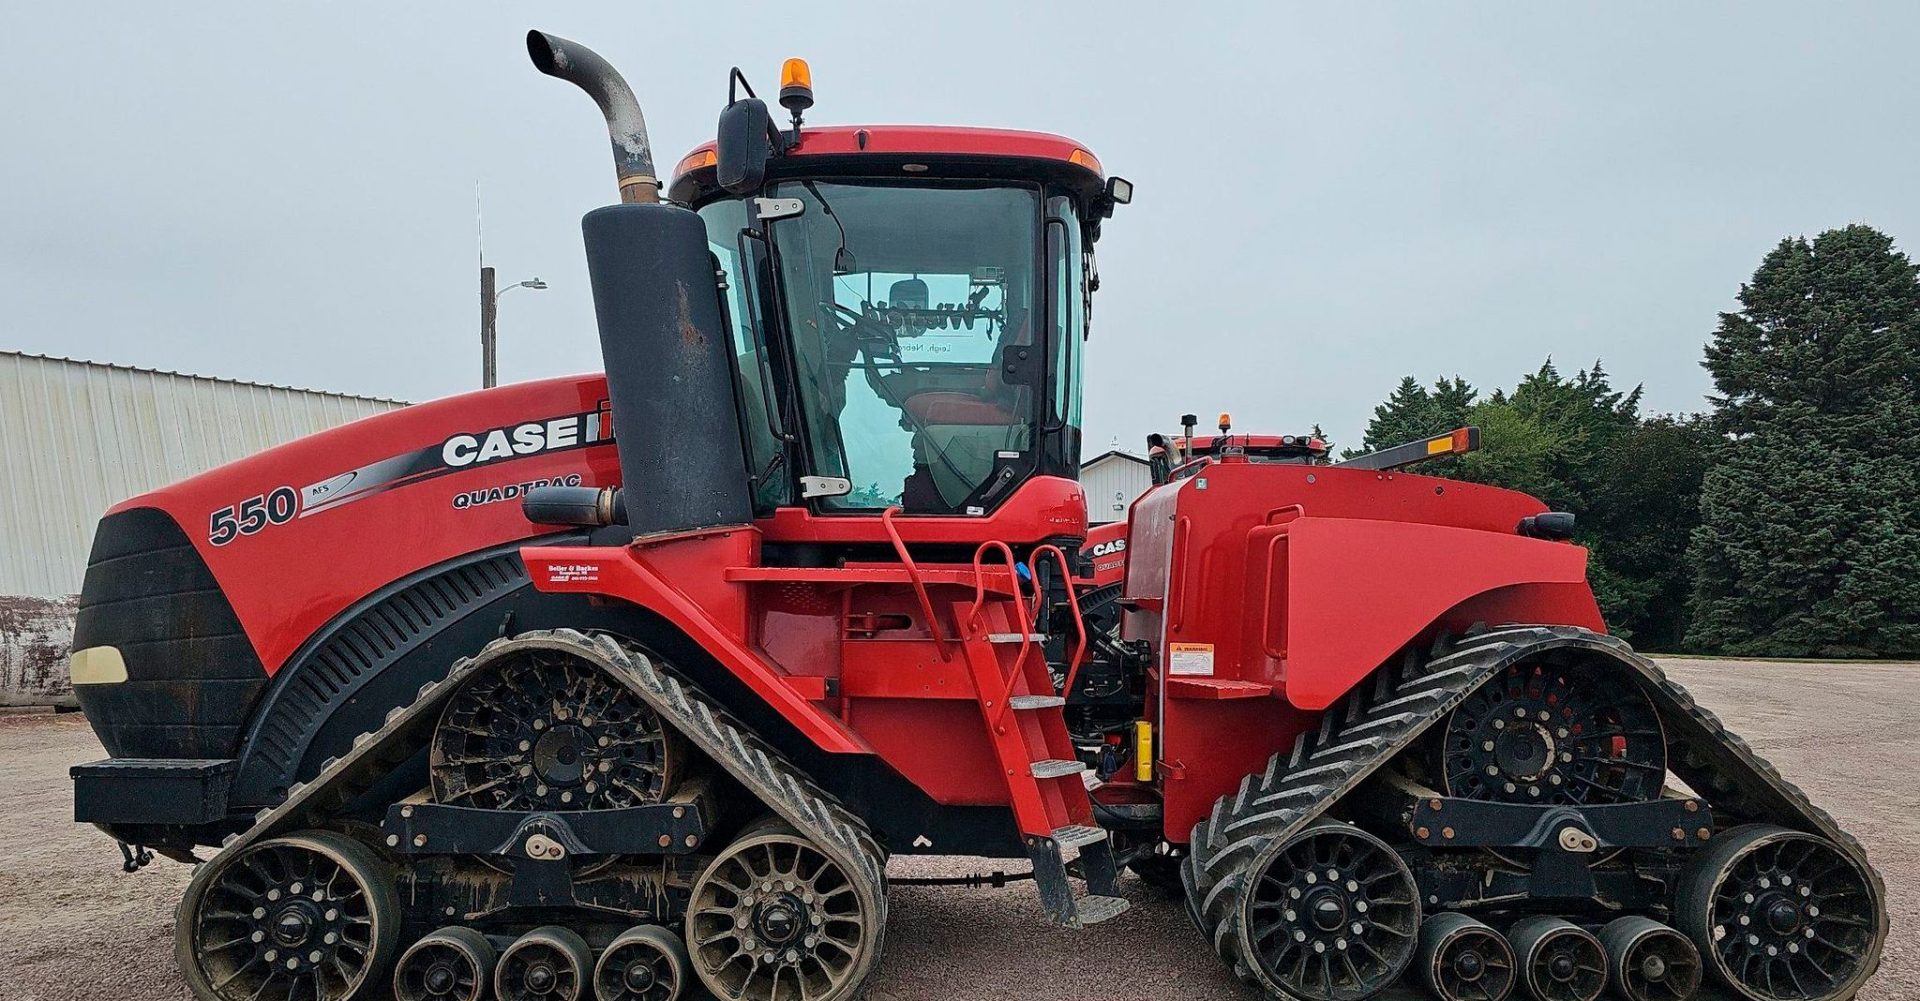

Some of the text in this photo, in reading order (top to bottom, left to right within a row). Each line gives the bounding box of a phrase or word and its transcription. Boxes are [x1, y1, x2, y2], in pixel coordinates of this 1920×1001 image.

[442, 416, 578, 467] CASE
[208, 484, 329, 547] 550 AFS
[1093, 539, 1126, 556] CAS
